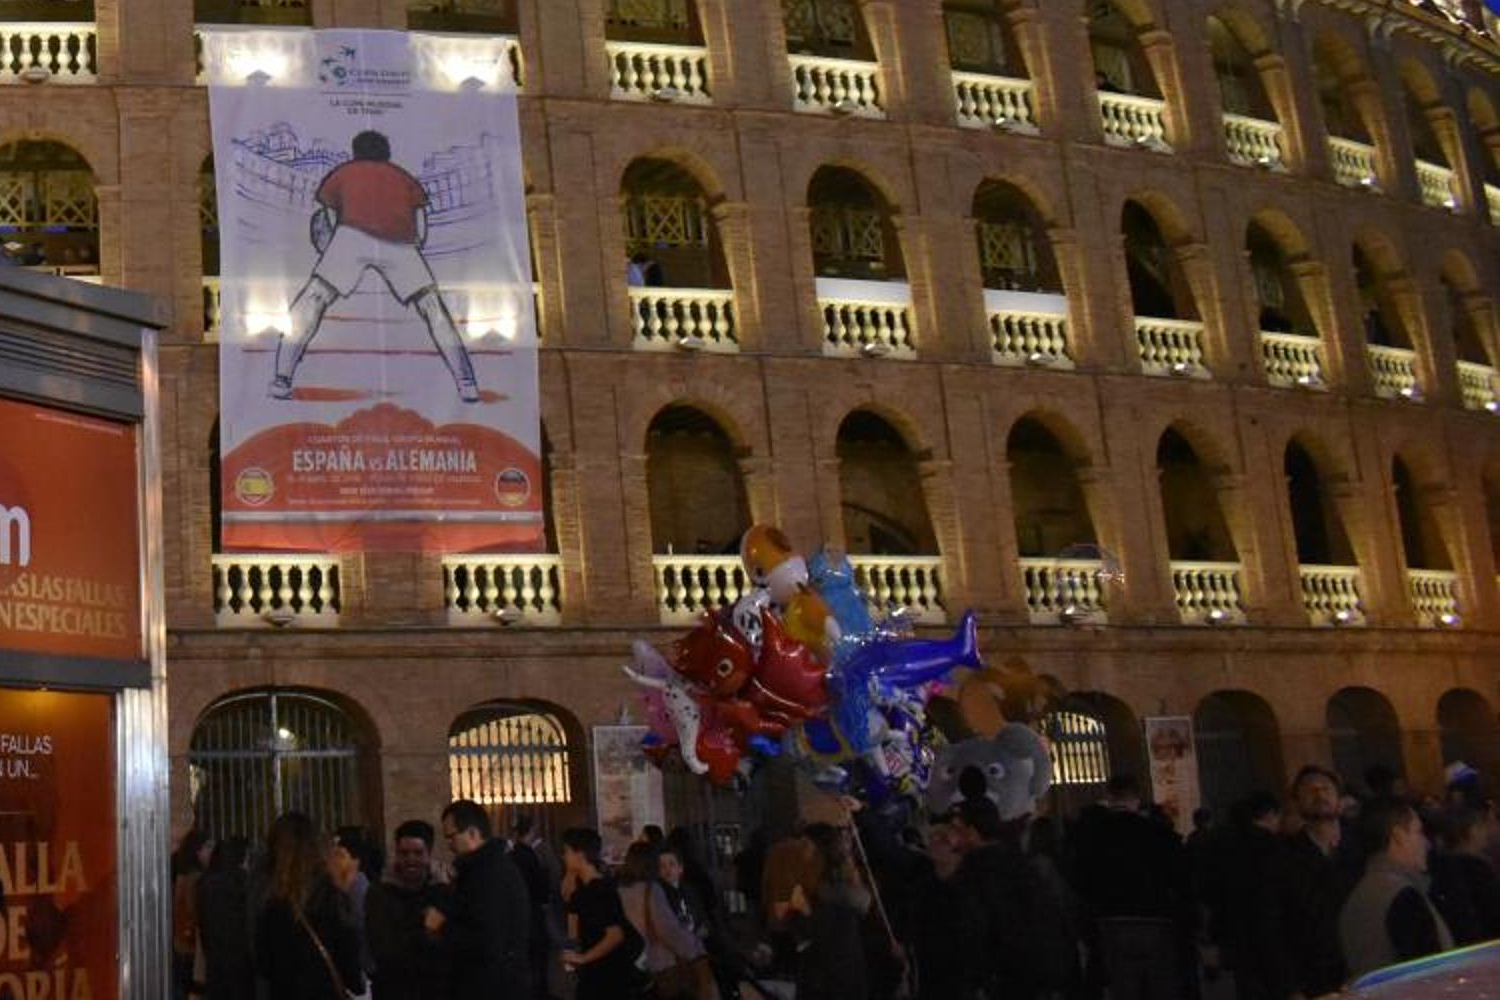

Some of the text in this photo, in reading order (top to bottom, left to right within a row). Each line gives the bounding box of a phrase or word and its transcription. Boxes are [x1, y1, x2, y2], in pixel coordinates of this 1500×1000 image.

[292, 444, 365, 472] ESPAÑA
[386, 449, 477, 473] ALEMANIA
[15, 602, 128, 638] ESPECIALES
[1, 735, 53, 755] FALLAS
